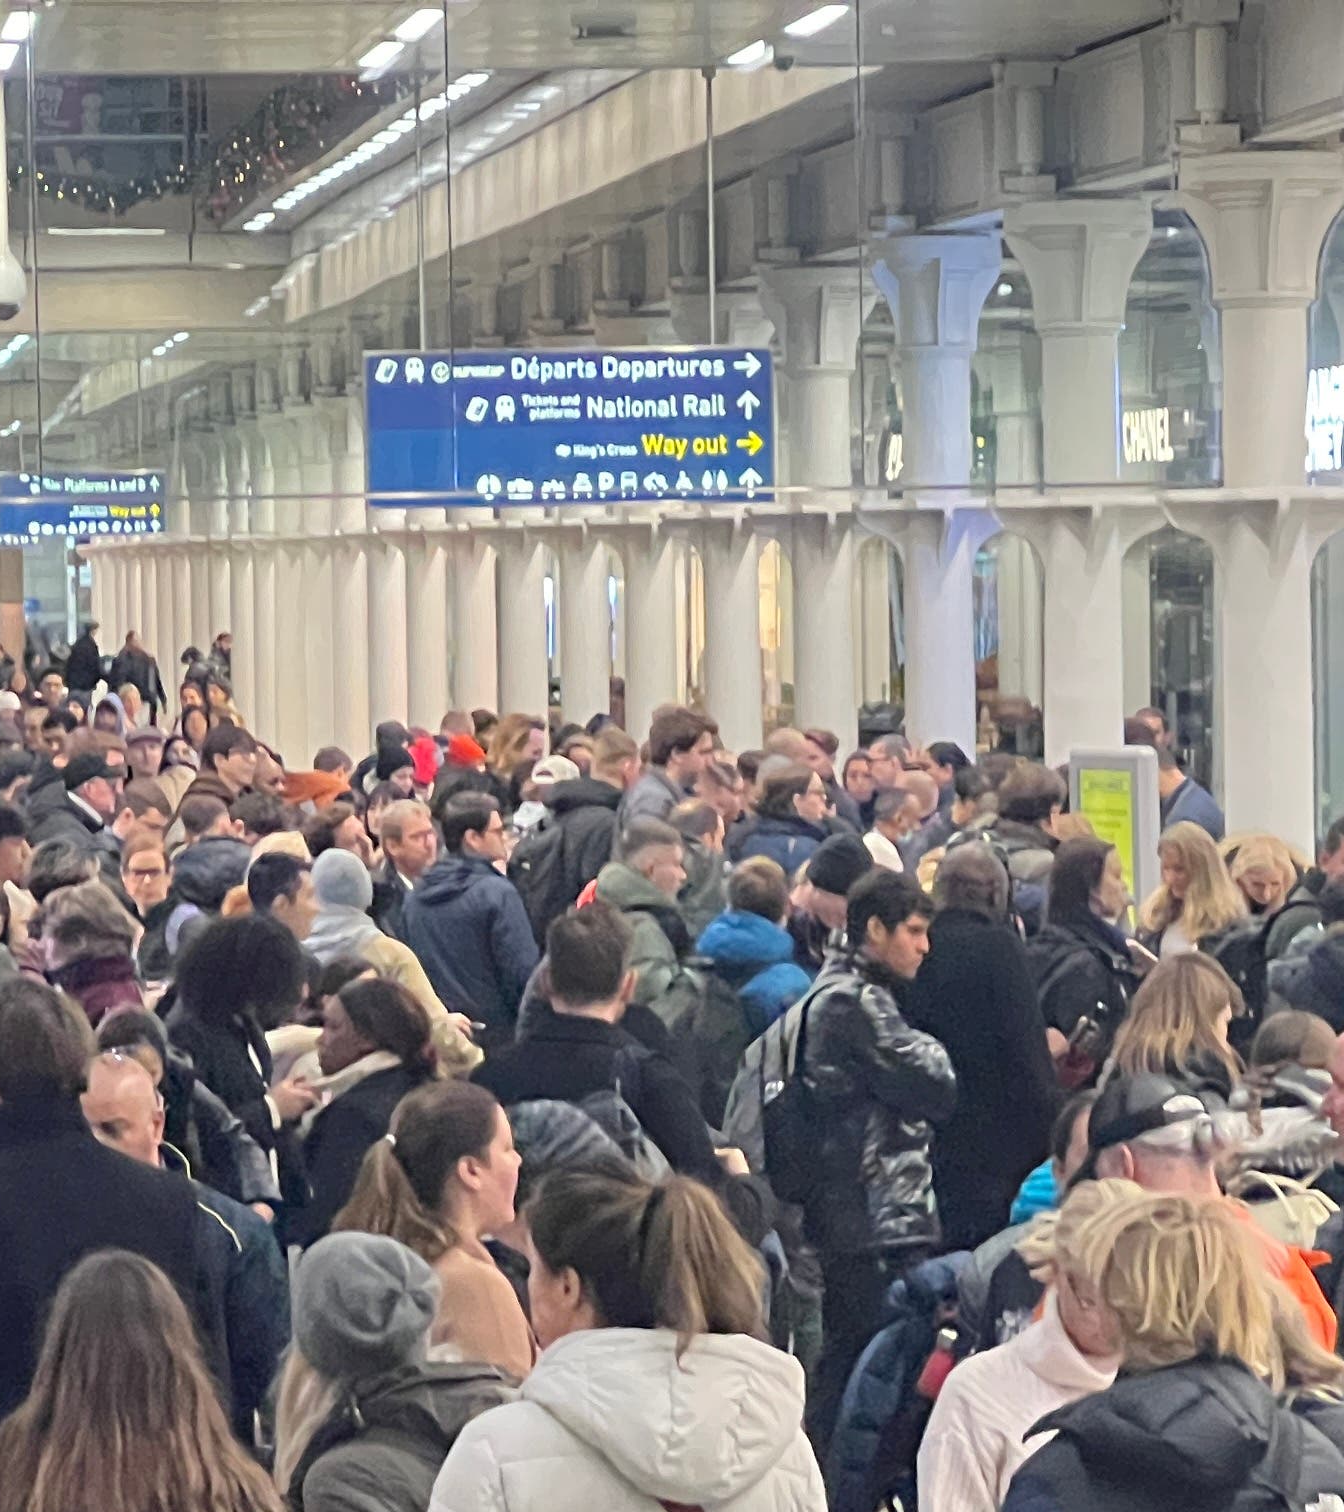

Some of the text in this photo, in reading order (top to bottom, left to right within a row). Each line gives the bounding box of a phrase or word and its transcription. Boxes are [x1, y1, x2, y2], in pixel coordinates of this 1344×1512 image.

[511, 356, 597, 384] Départs
[602, 355, 725, 383] Departures
[587, 394, 726, 419] National Rail
[641, 433, 728, 460] Way out
[1123, 407, 1174, 463] CHANEL
